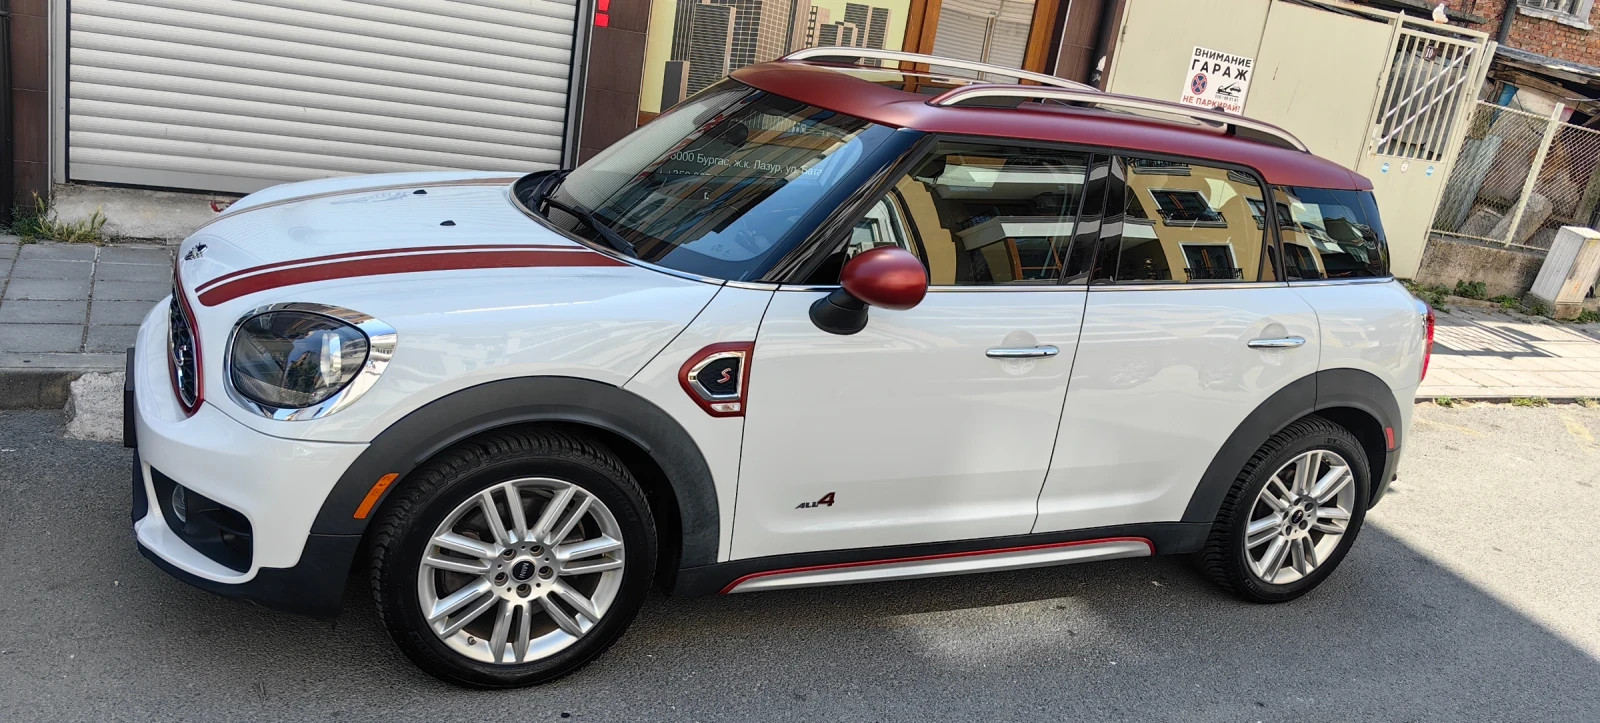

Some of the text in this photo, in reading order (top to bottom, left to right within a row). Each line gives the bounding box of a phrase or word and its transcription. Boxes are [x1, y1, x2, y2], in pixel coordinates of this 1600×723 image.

[1194, 47, 1252, 68] ВНИМАНИЕ
[1191, 59, 1249, 81] ГАРАЖ
[1182, 95, 1194, 104] НЕ
[696, 153, 731, 167] Бургас,
[734, 159, 751, 169] ж.к.
[753, 159, 783, 174] Лазур,
[716, 367, 732, 384] S
